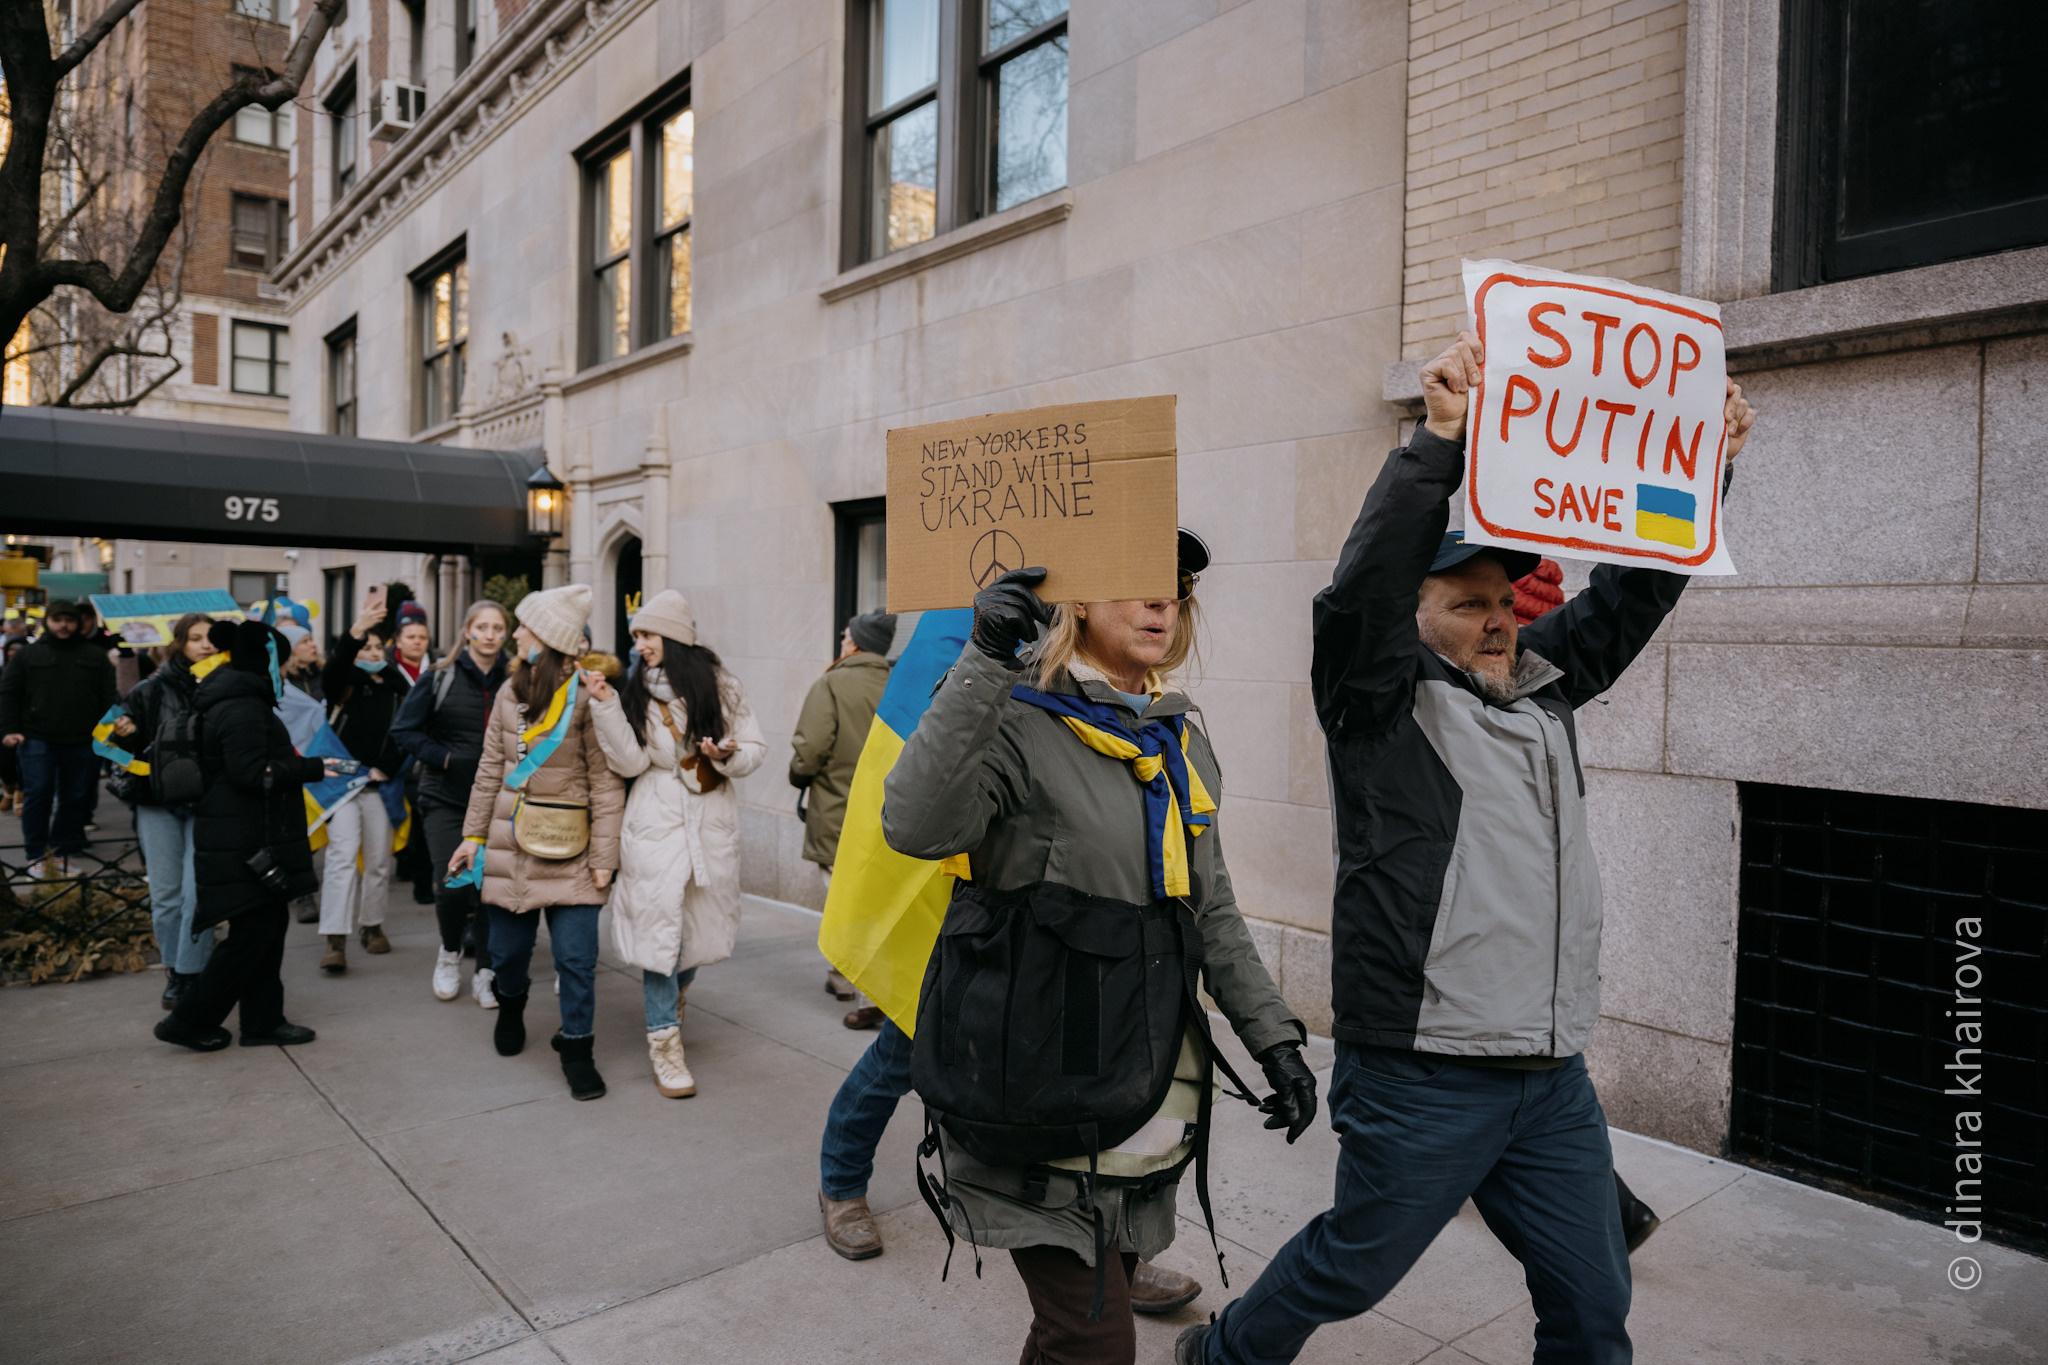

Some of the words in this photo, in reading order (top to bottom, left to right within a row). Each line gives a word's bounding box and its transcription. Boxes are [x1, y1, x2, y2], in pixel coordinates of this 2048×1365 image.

[1527, 301, 1701, 398] STOP
[921, 438, 969, 463] NEW
[975, 423, 1087, 456] YORKERS
[1500, 374, 1705, 481] PUTIN
[920, 459, 1002, 497] STAND
[1012, 449, 1090, 483] WITH
[224, 495, 280, 522] 975
[920, 480, 1093, 532] UKRAINE
[1533, 477, 1624, 532] SAVE
